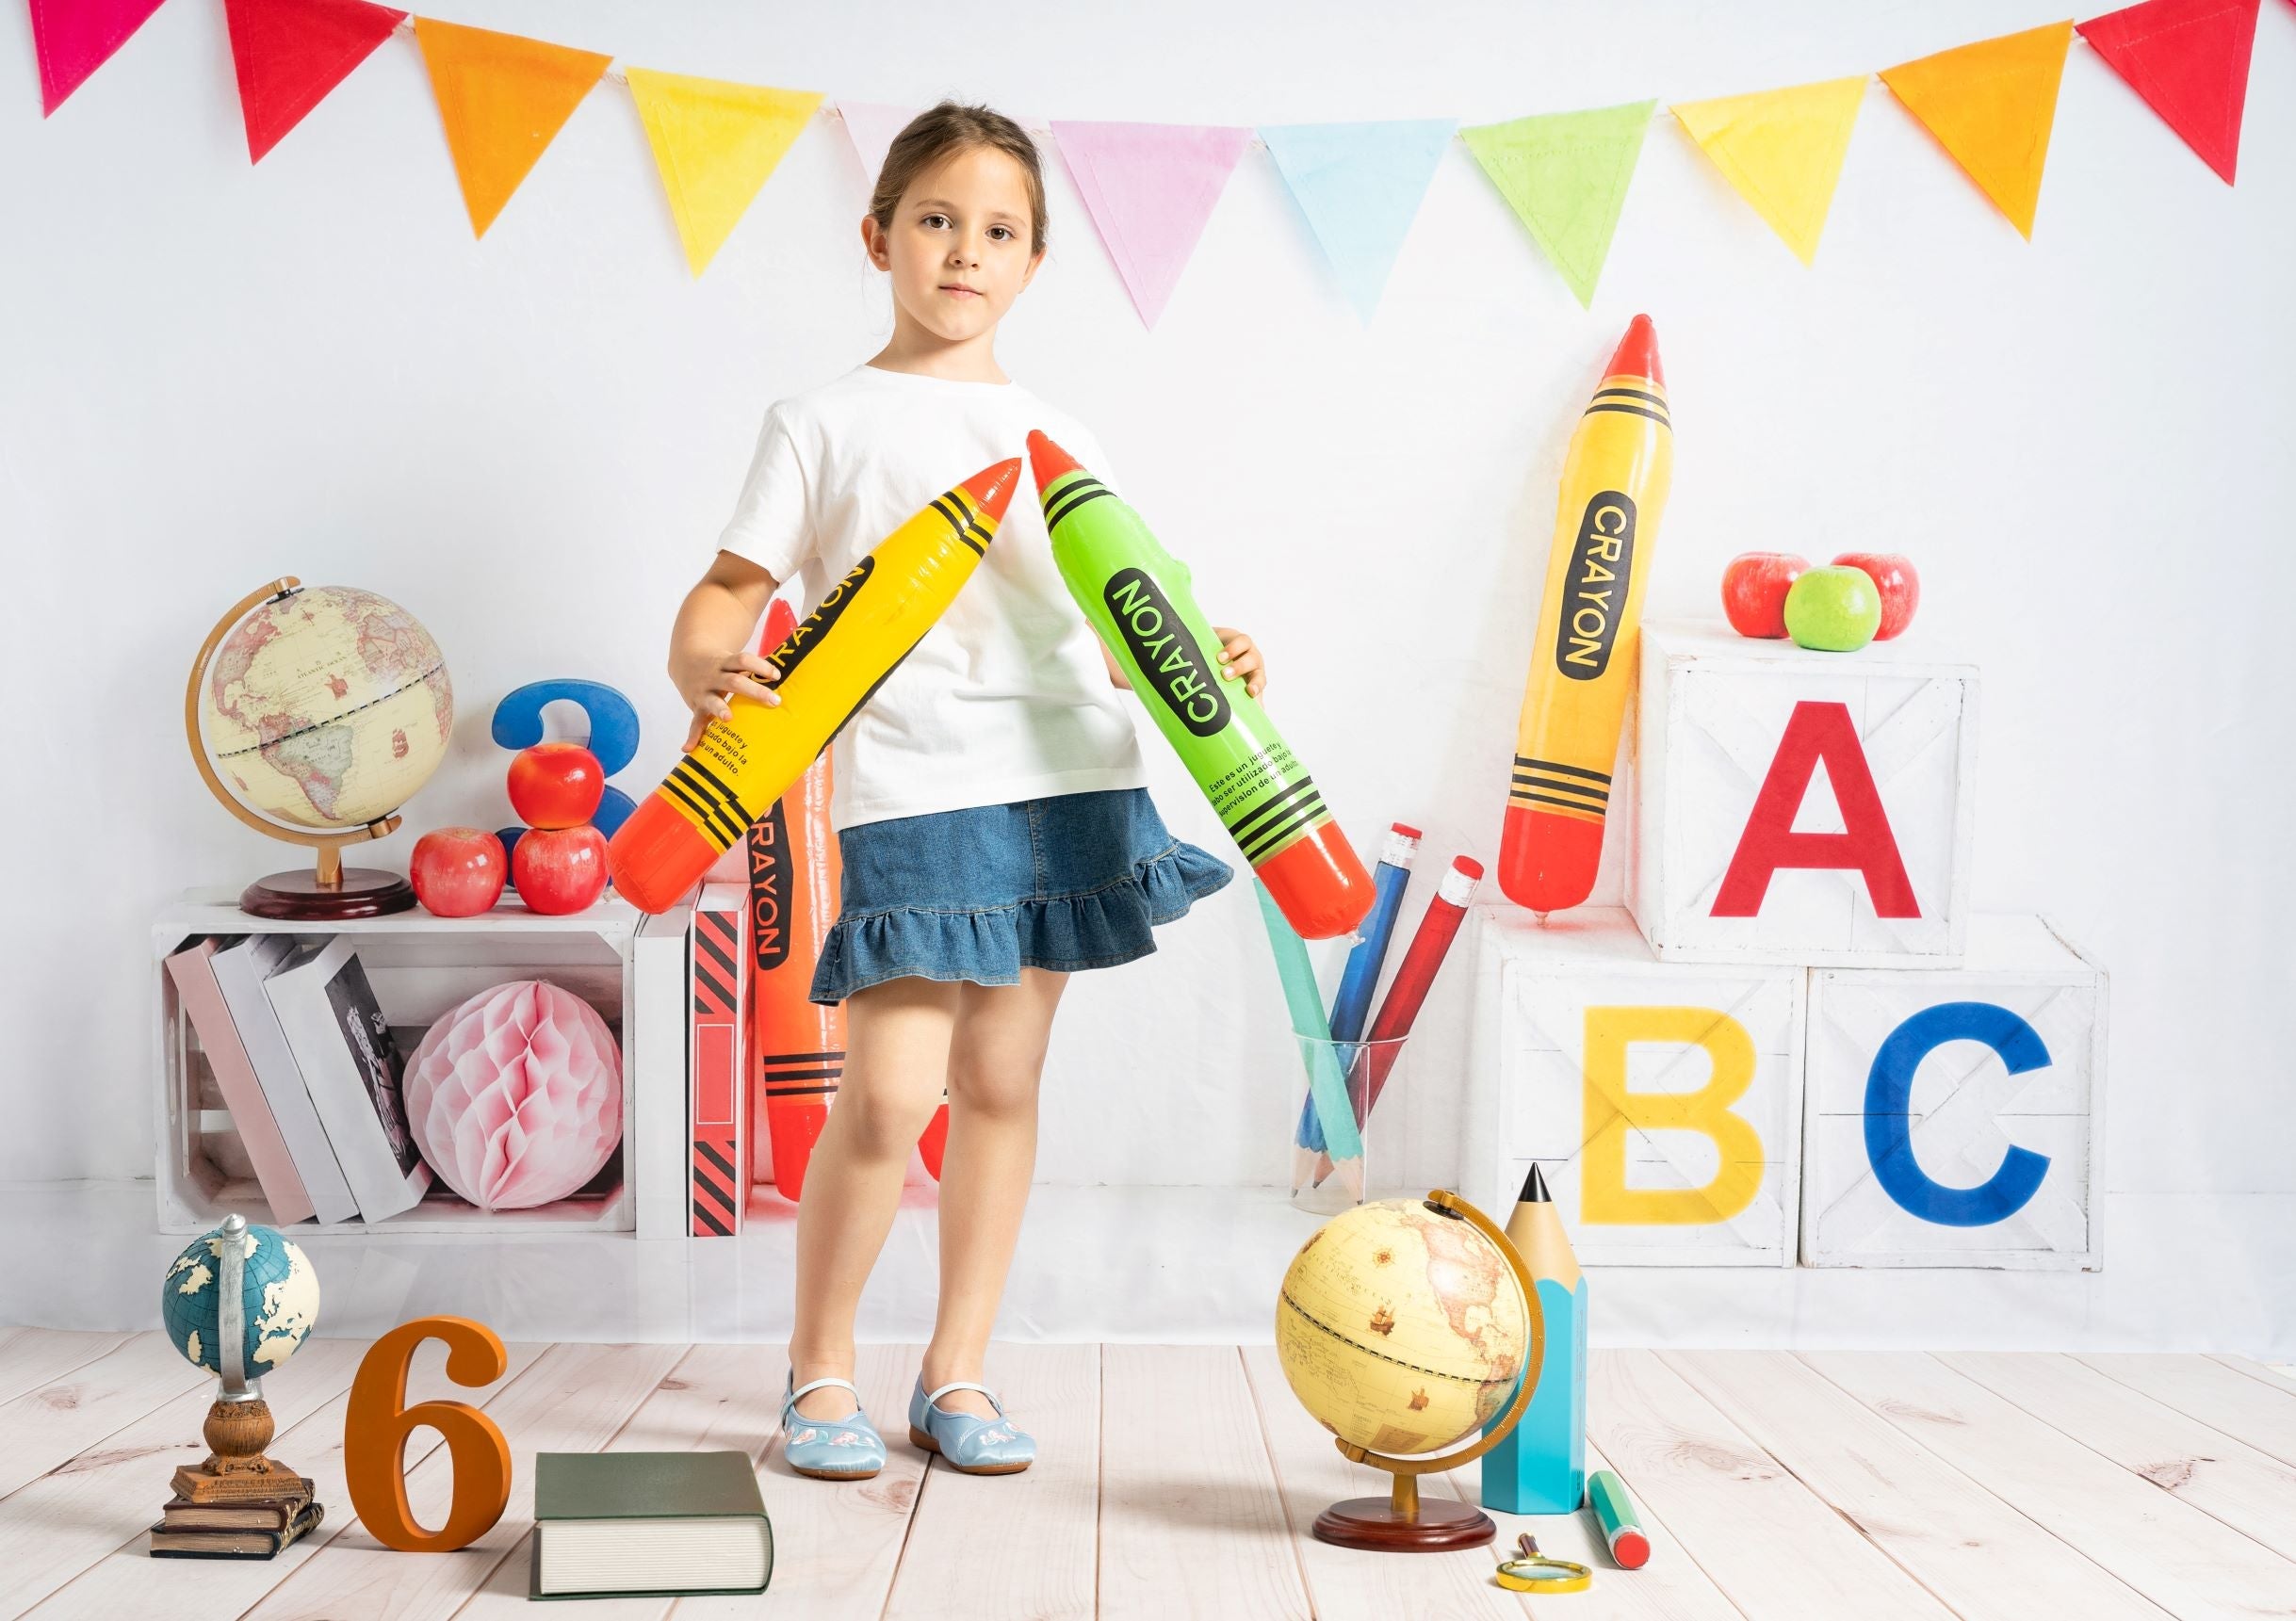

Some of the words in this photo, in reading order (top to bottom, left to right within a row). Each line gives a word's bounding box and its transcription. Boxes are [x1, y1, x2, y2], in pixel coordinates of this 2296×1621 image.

[1112, 579, 1218, 722] CRAYON
[1565, 505, 1627, 667] CRAYON
[704, 744, 714, 754] un
[713, 752, 739, 776] adulto.
[722, 740, 739, 757] bajo
[738, 754, 747, 765] la
[1209, 779, 1226, 792] Este
[1225, 771, 1235, 781] es
[1235, 763, 1248, 773] un
[1223, 785, 1236, 797] ser
[1236, 760, 1273, 787] utilizado
[1258, 777, 1270, 788] de
[1270, 770, 1281, 781] un
[1708, 700, 1923, 919] A
[750, 805, 781, 955] RAYON
[1580, 1006, 1765, 1225] B
[1864, 1001, 2052, 1227] C
[344, 1314, 513, 1552] 6
